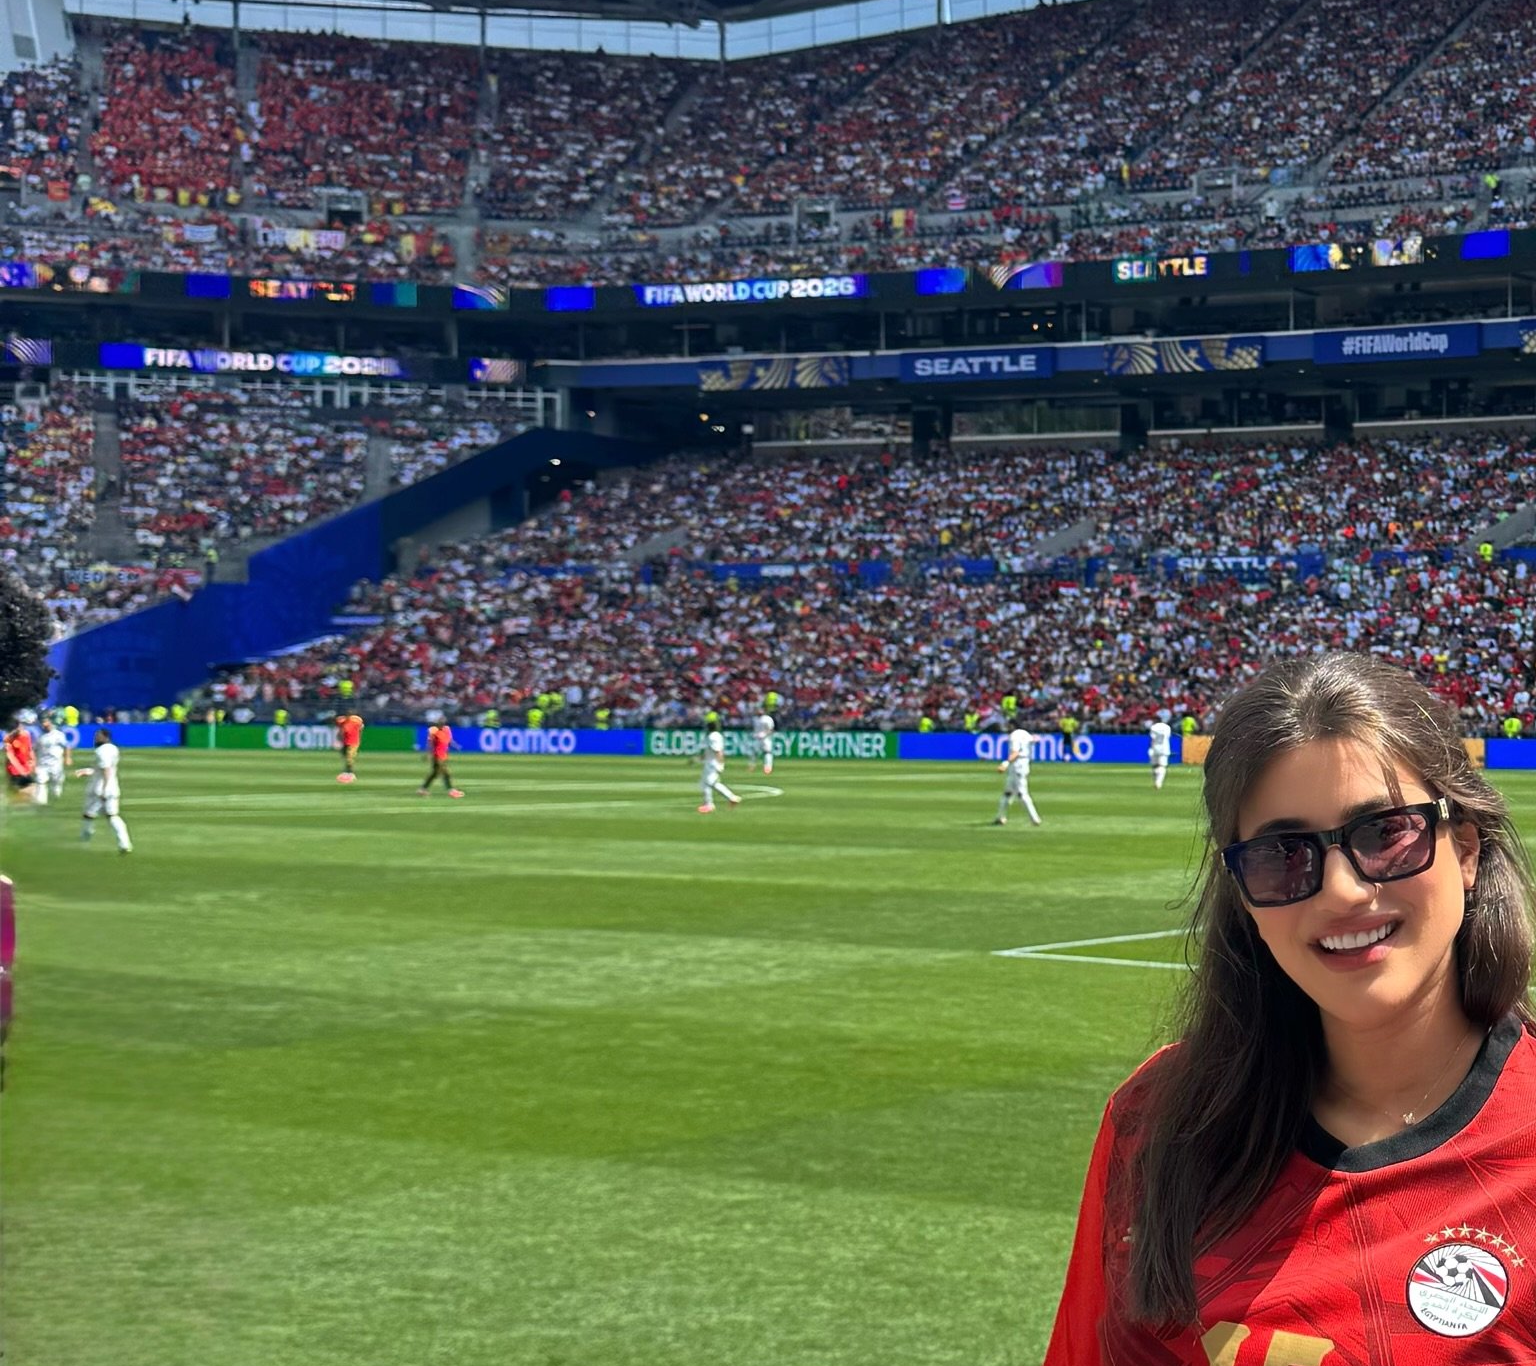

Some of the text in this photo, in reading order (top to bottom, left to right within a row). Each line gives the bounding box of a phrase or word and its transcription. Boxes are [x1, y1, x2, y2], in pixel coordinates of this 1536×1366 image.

[644, 277, 856, 304] FIFA WORLD CUP 2026
[143, 347, 193, 368] FIFA
[276, 352, 321, 373] CUP
[914, 354, 1037, 377] SEATTLE
[479, 727, 576, 754] aramco
[799, 732, 887, 758] PARTNER
